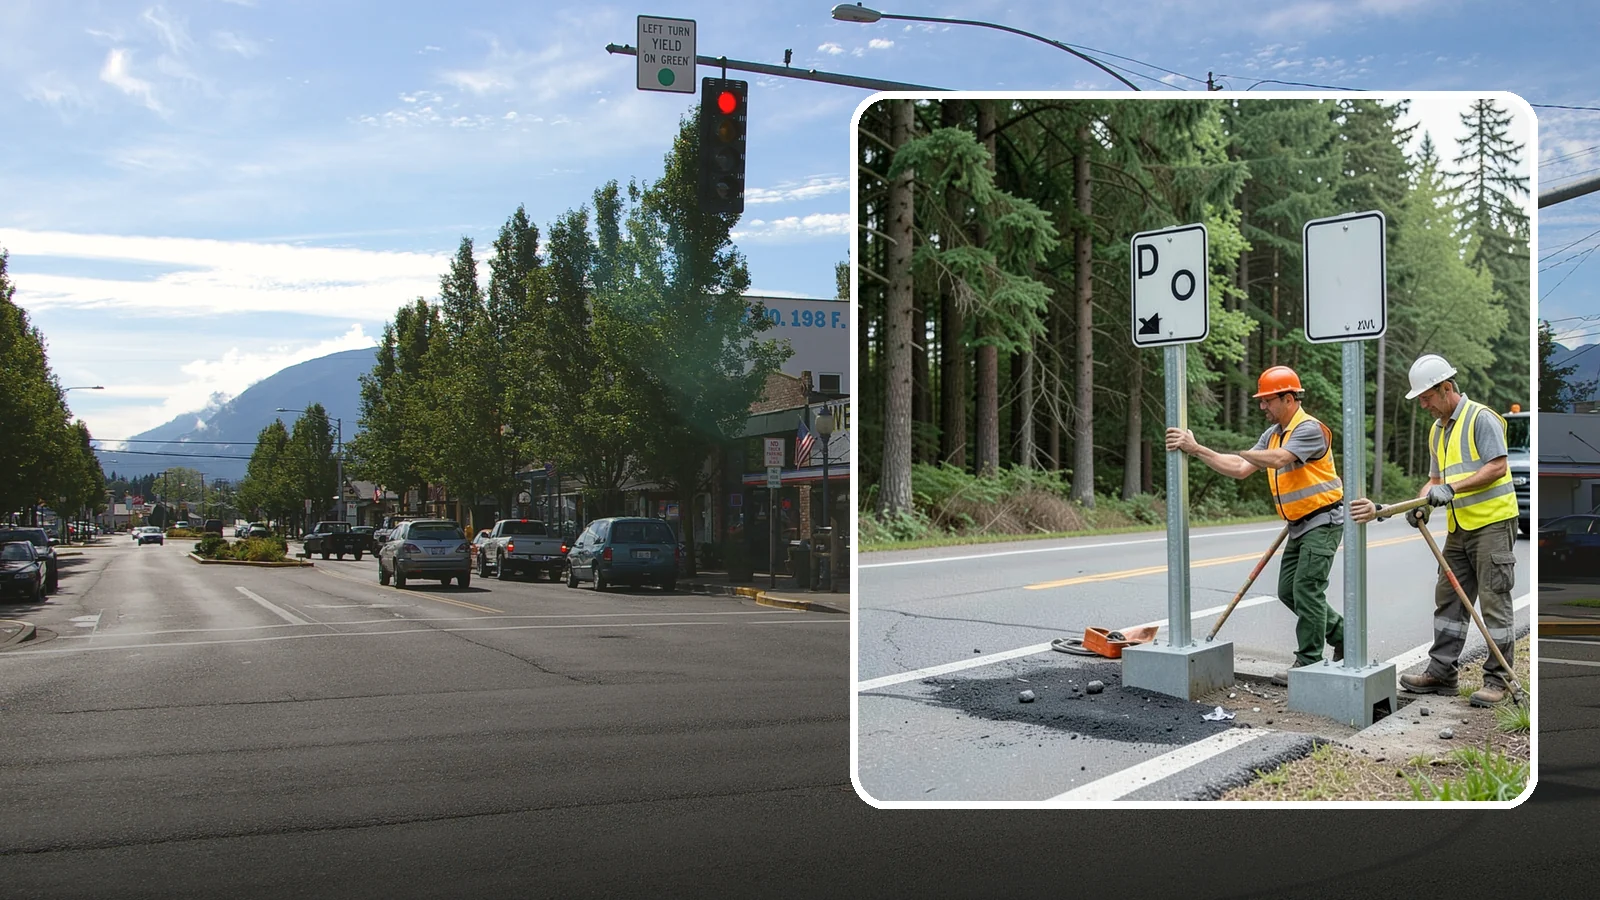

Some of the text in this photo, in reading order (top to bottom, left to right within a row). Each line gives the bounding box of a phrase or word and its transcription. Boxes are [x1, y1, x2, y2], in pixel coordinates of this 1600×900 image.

[643, 24, 690, 36] LEFT TURN
[652, 38, 682, 52] YIELD
[644, 53, 689, 66] ON GREEN
[791, 309, 826, 328] 198
[831, 311, 847, 329] F.
